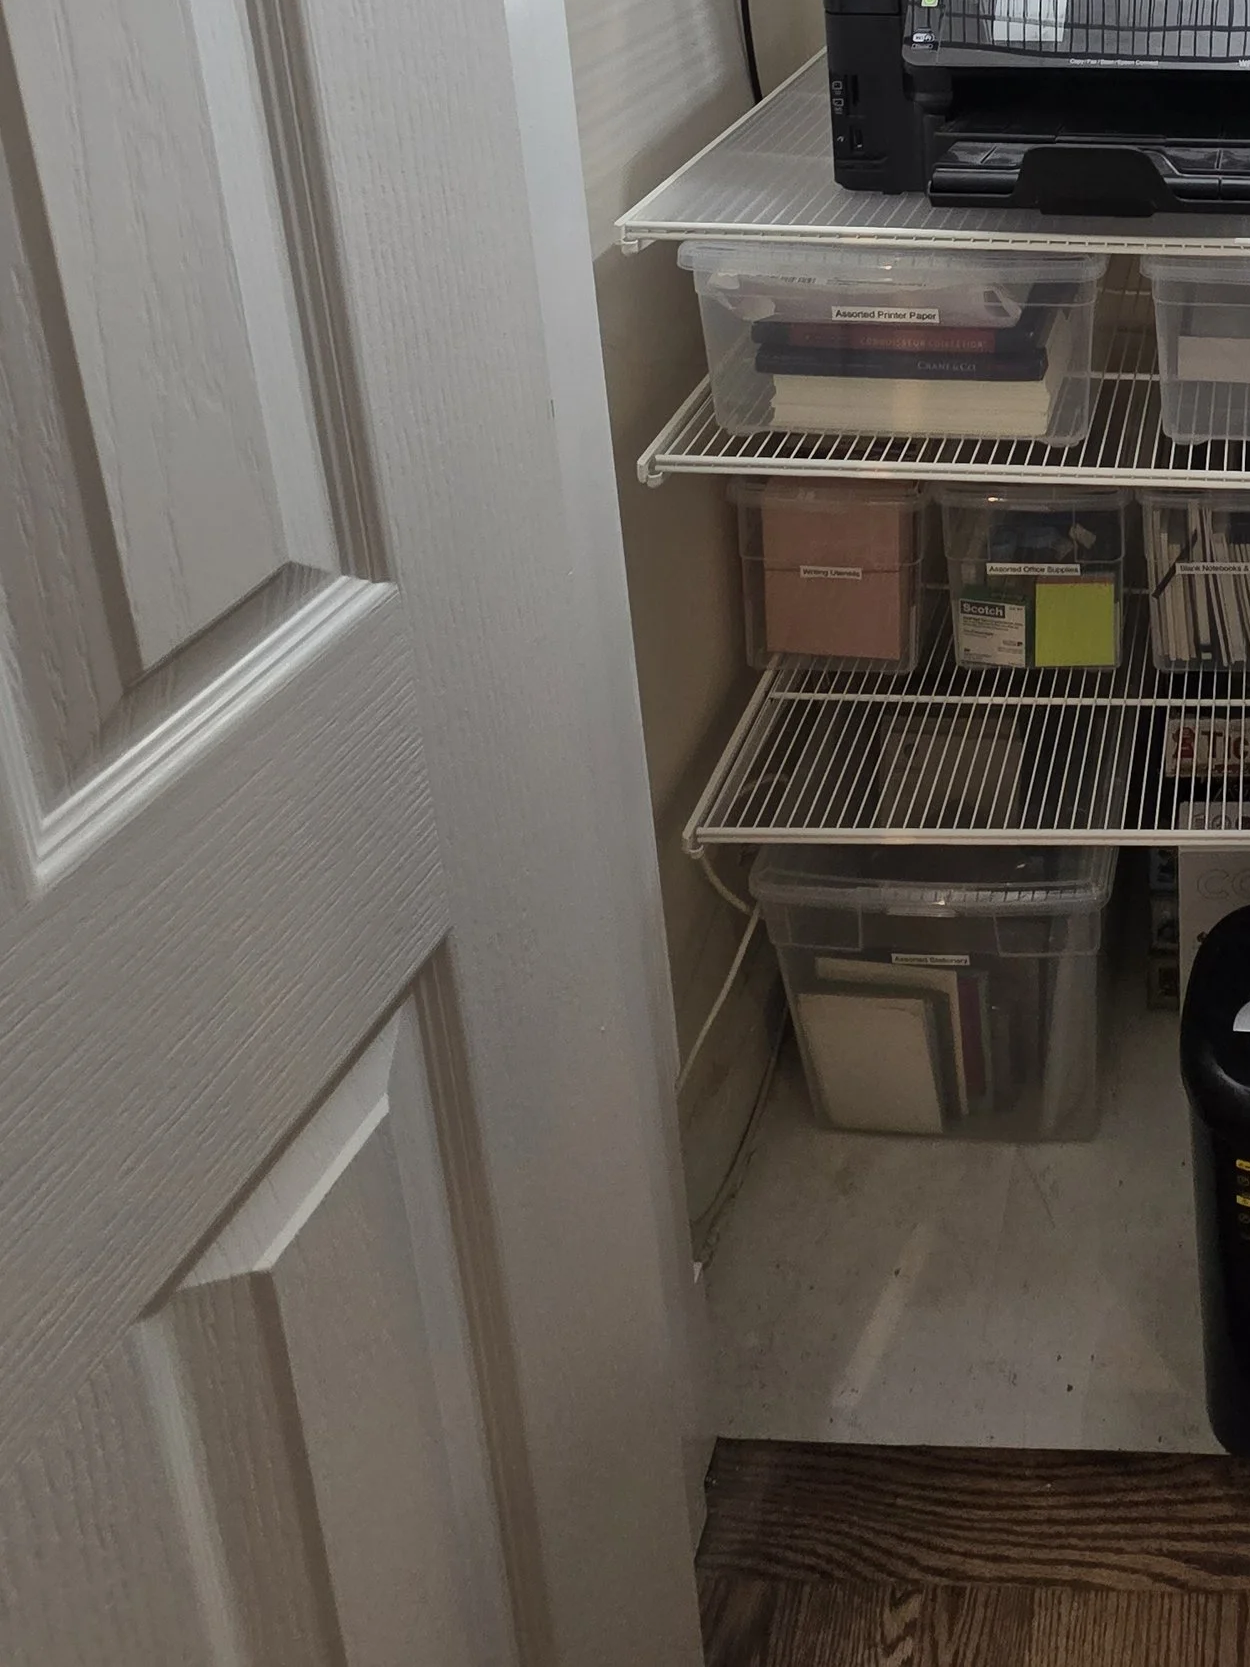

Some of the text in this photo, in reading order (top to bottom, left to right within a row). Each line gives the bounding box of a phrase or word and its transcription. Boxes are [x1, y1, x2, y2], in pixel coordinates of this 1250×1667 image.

[835, 309, 937, 322] Assorted Printer Paper
[989, 565, 1079, 574] Assorted Office Supplies
[962, 602, 1004, 617] Scotch
